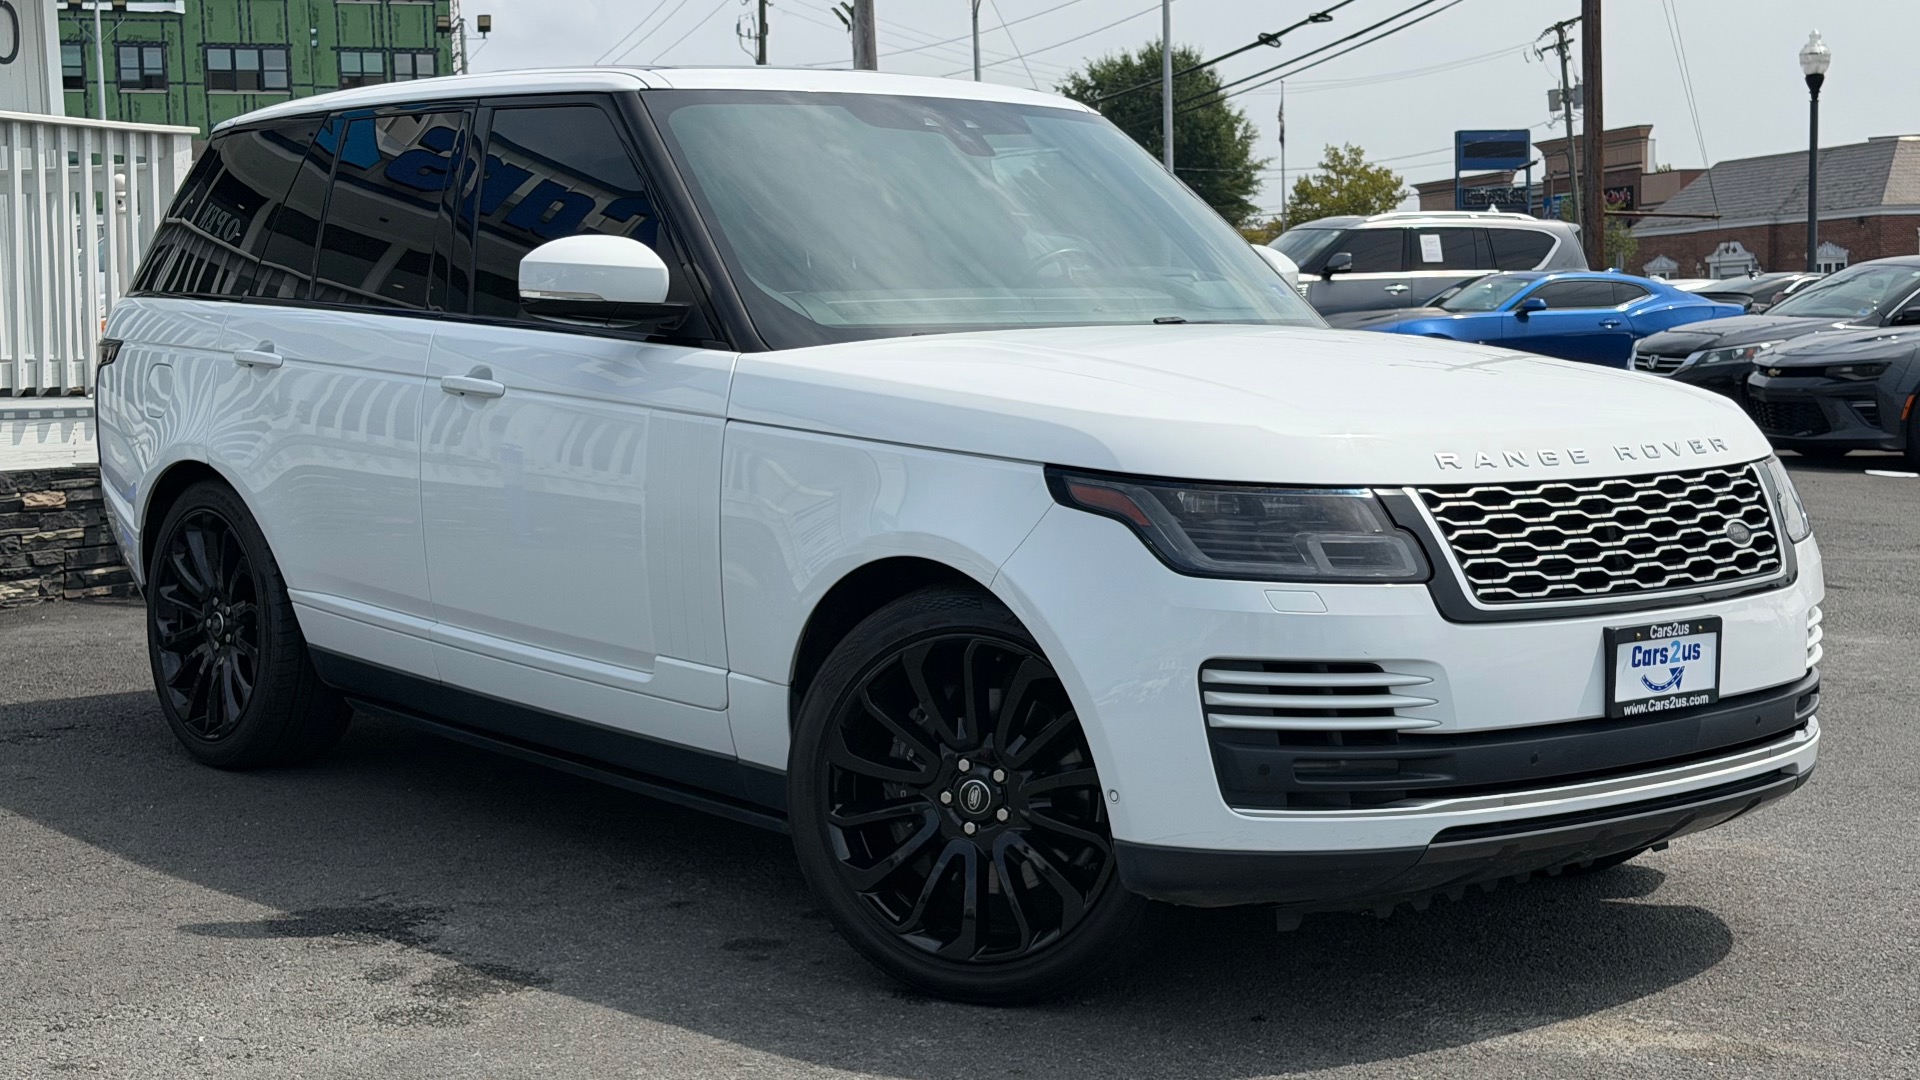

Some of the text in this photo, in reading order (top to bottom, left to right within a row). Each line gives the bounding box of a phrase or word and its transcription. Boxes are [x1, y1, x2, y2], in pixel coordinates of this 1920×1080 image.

[1434, 437, 1728, 470] RANGE ROVER
[1649, 622, 1690, 639] Cars2us
[1631, 640, 1701, 668] Cars2us
[1623, 694, 1709, 716] www.Cars2us.com
